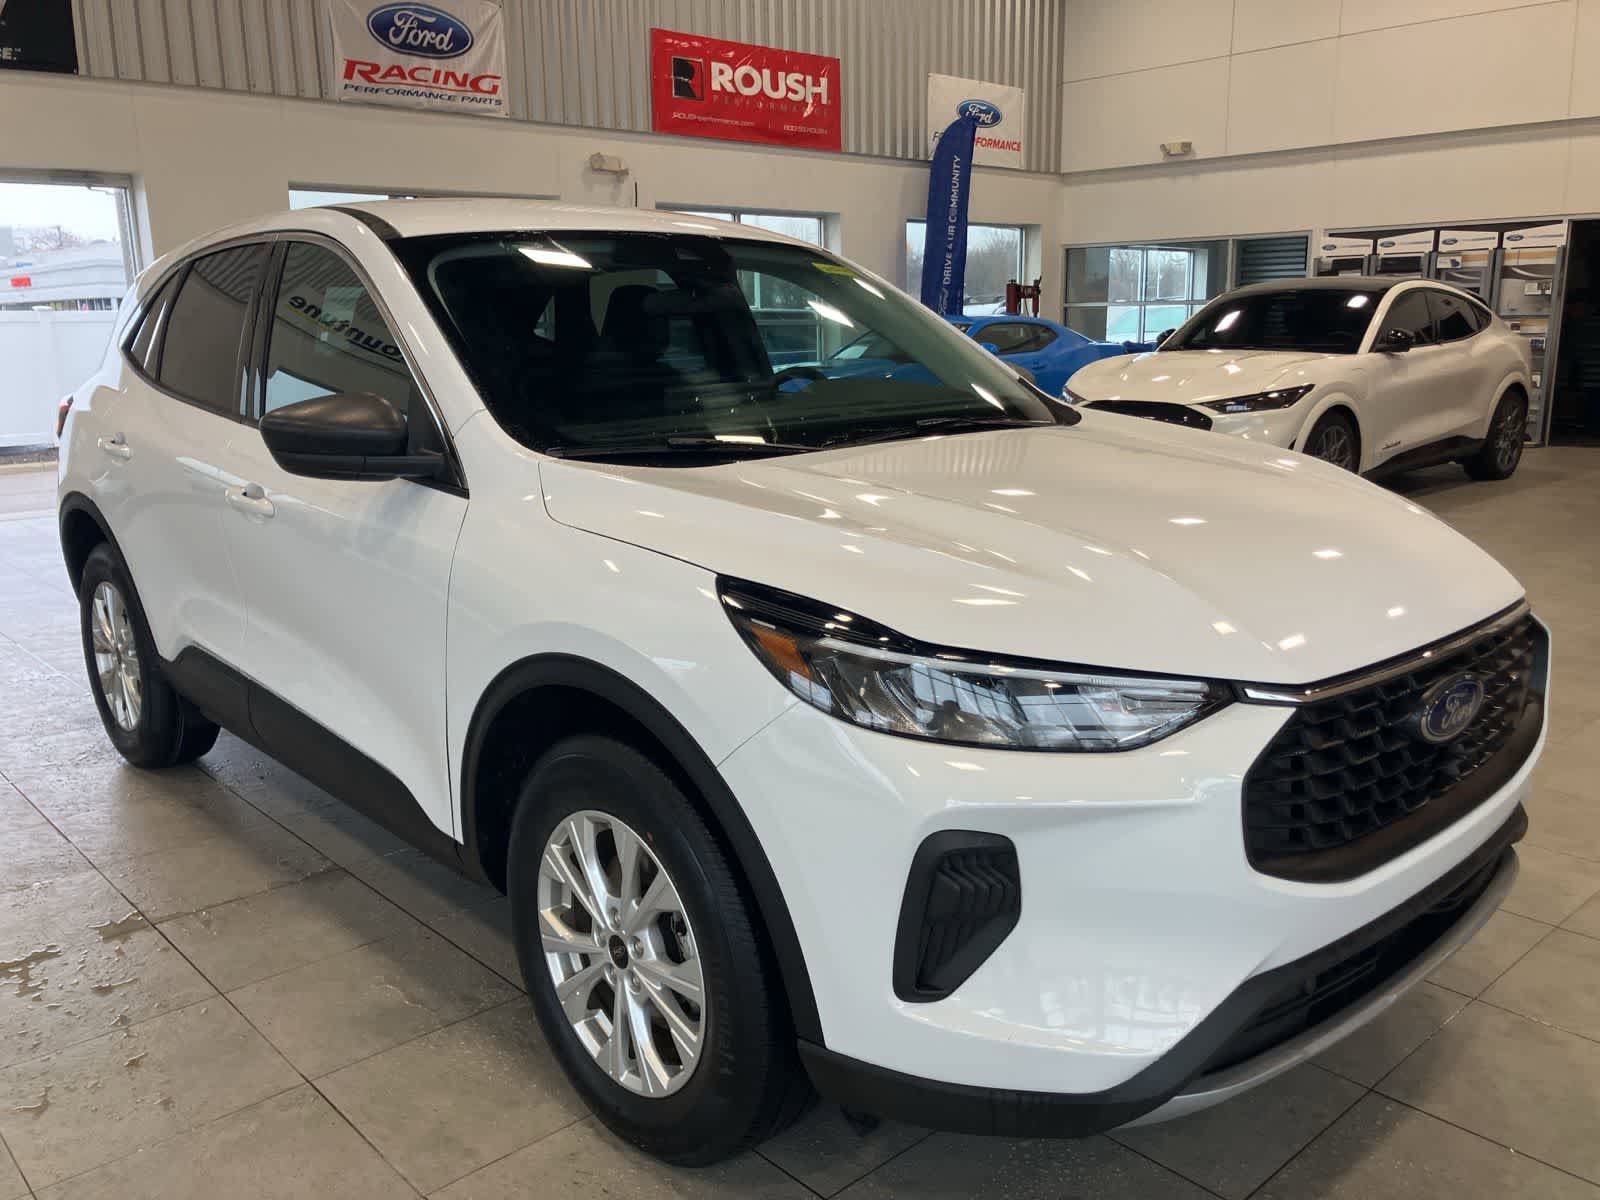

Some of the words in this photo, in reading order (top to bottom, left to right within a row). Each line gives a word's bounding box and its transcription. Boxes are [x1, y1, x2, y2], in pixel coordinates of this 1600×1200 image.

[388, 10, 453, 51] Ford
[343, 59, 502, 95] RACING
[343, 83, 458, 102] PERFORMANCE
[460, 95, 502, 106] PARTS
[710, 61, 829, 105] ROUSH
[965, 103, 993, 124] Ford
[975, 136, 1022, 152] FORMANCE
[943, 251, 953, 285] DRIVE
[948, 155, 962, 223] COMMUNITY
